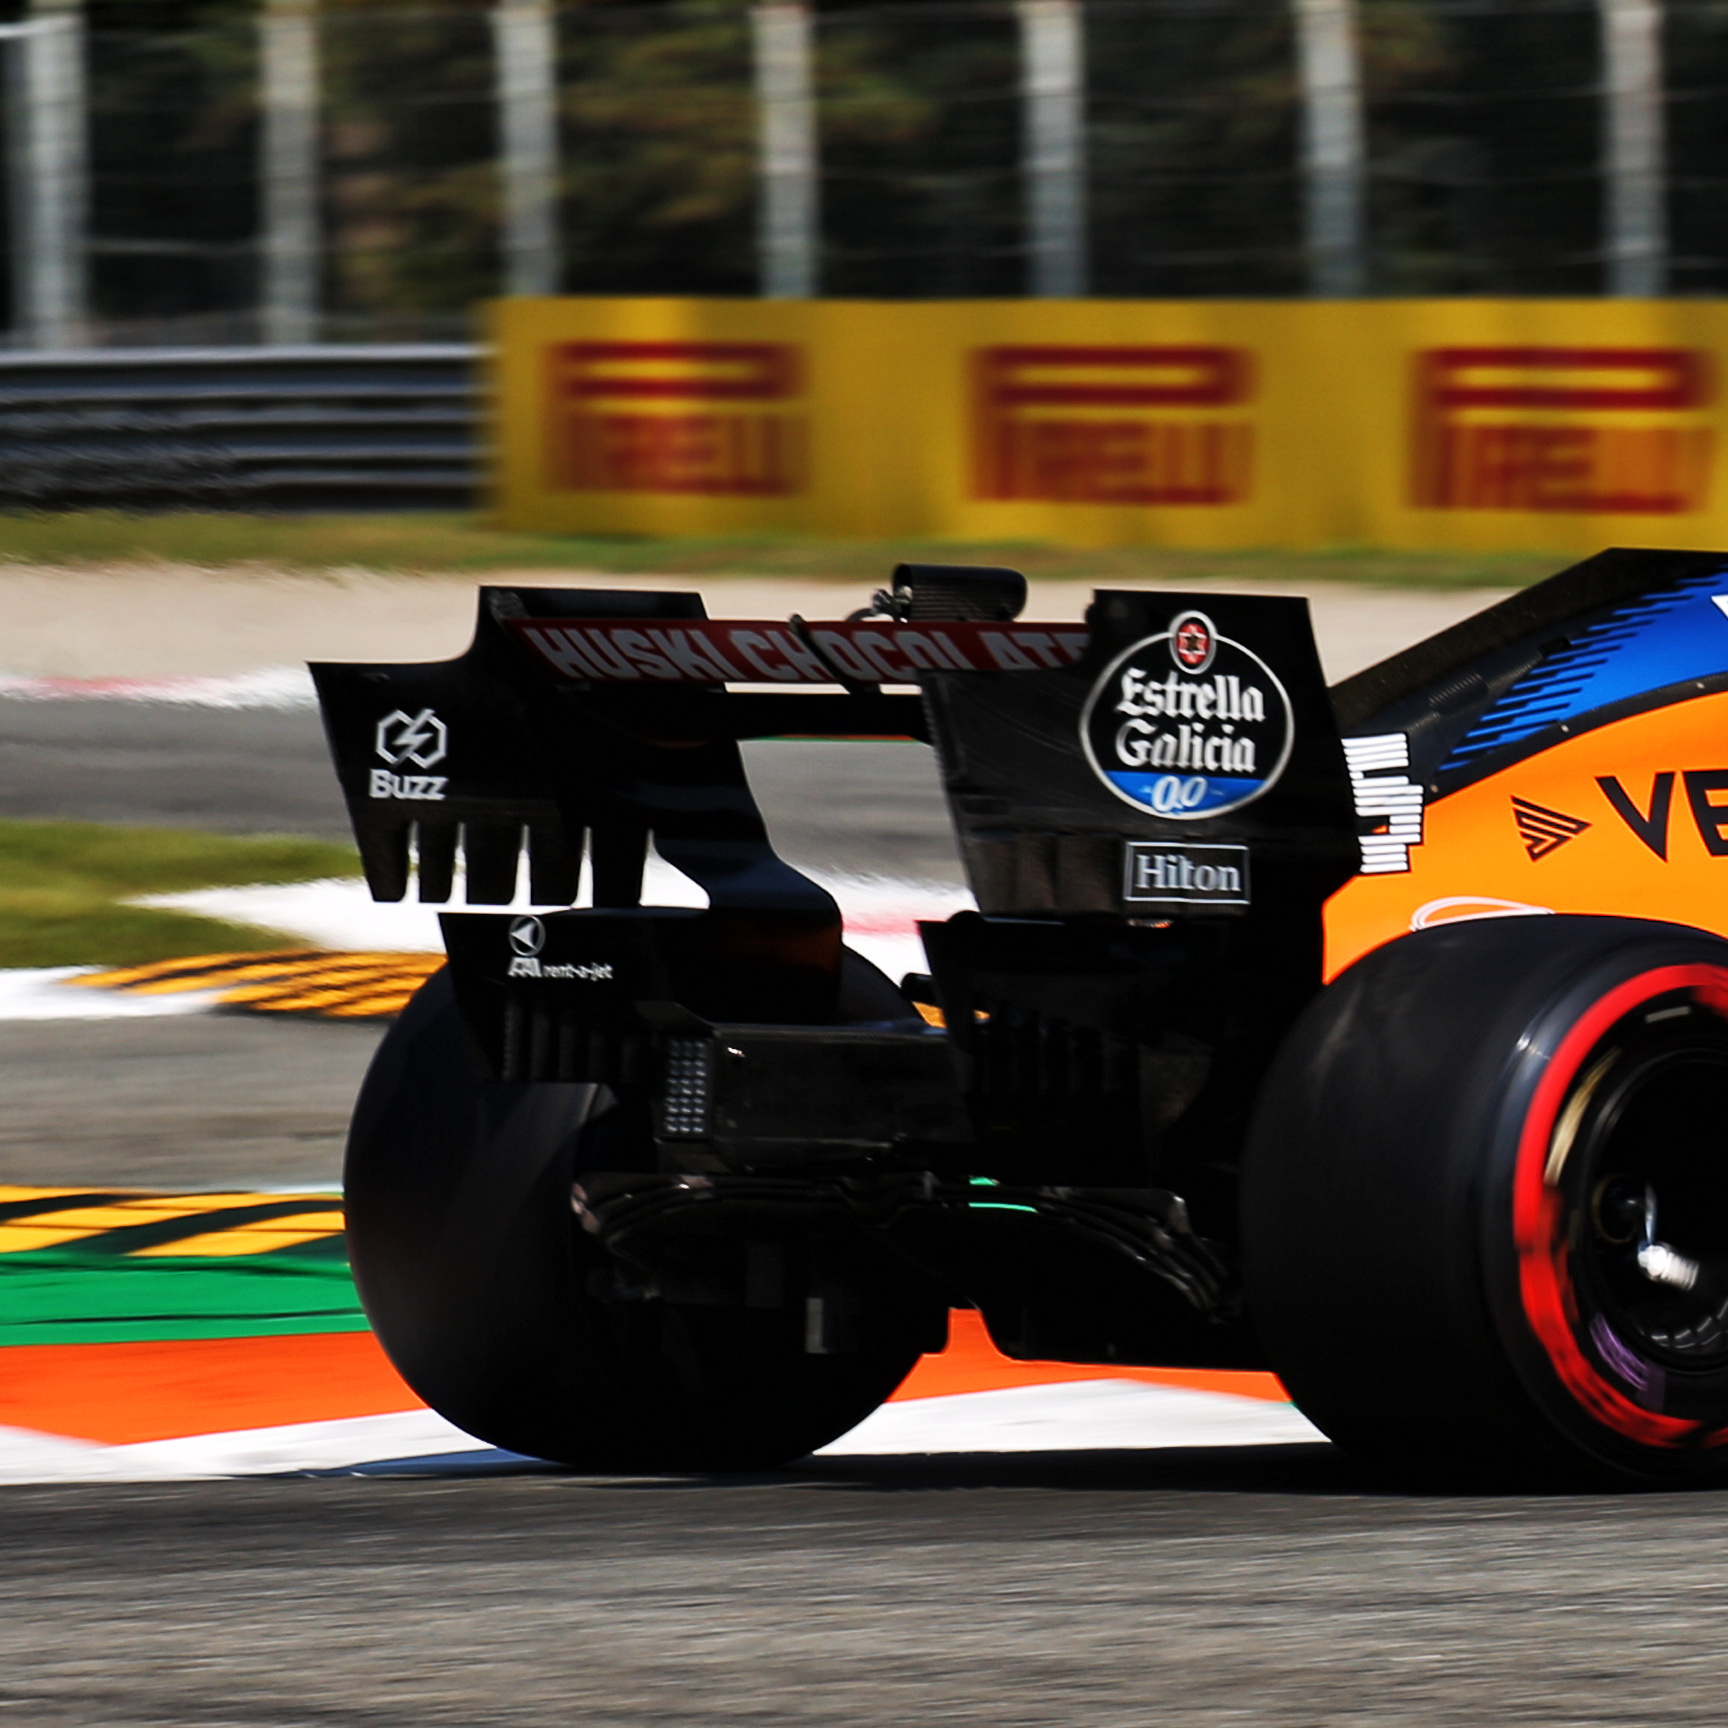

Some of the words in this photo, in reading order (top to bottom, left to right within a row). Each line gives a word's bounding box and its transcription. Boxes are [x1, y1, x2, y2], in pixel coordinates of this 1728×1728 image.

[521, 627, 748, 680] HUSKI
[1115, 666, 1266, 722] Estrella
[1115, 718, 1257, 772] Galicia
[369, 768, 449, 800] Buzz
[1134, 854, 1242, 892] Hilton
